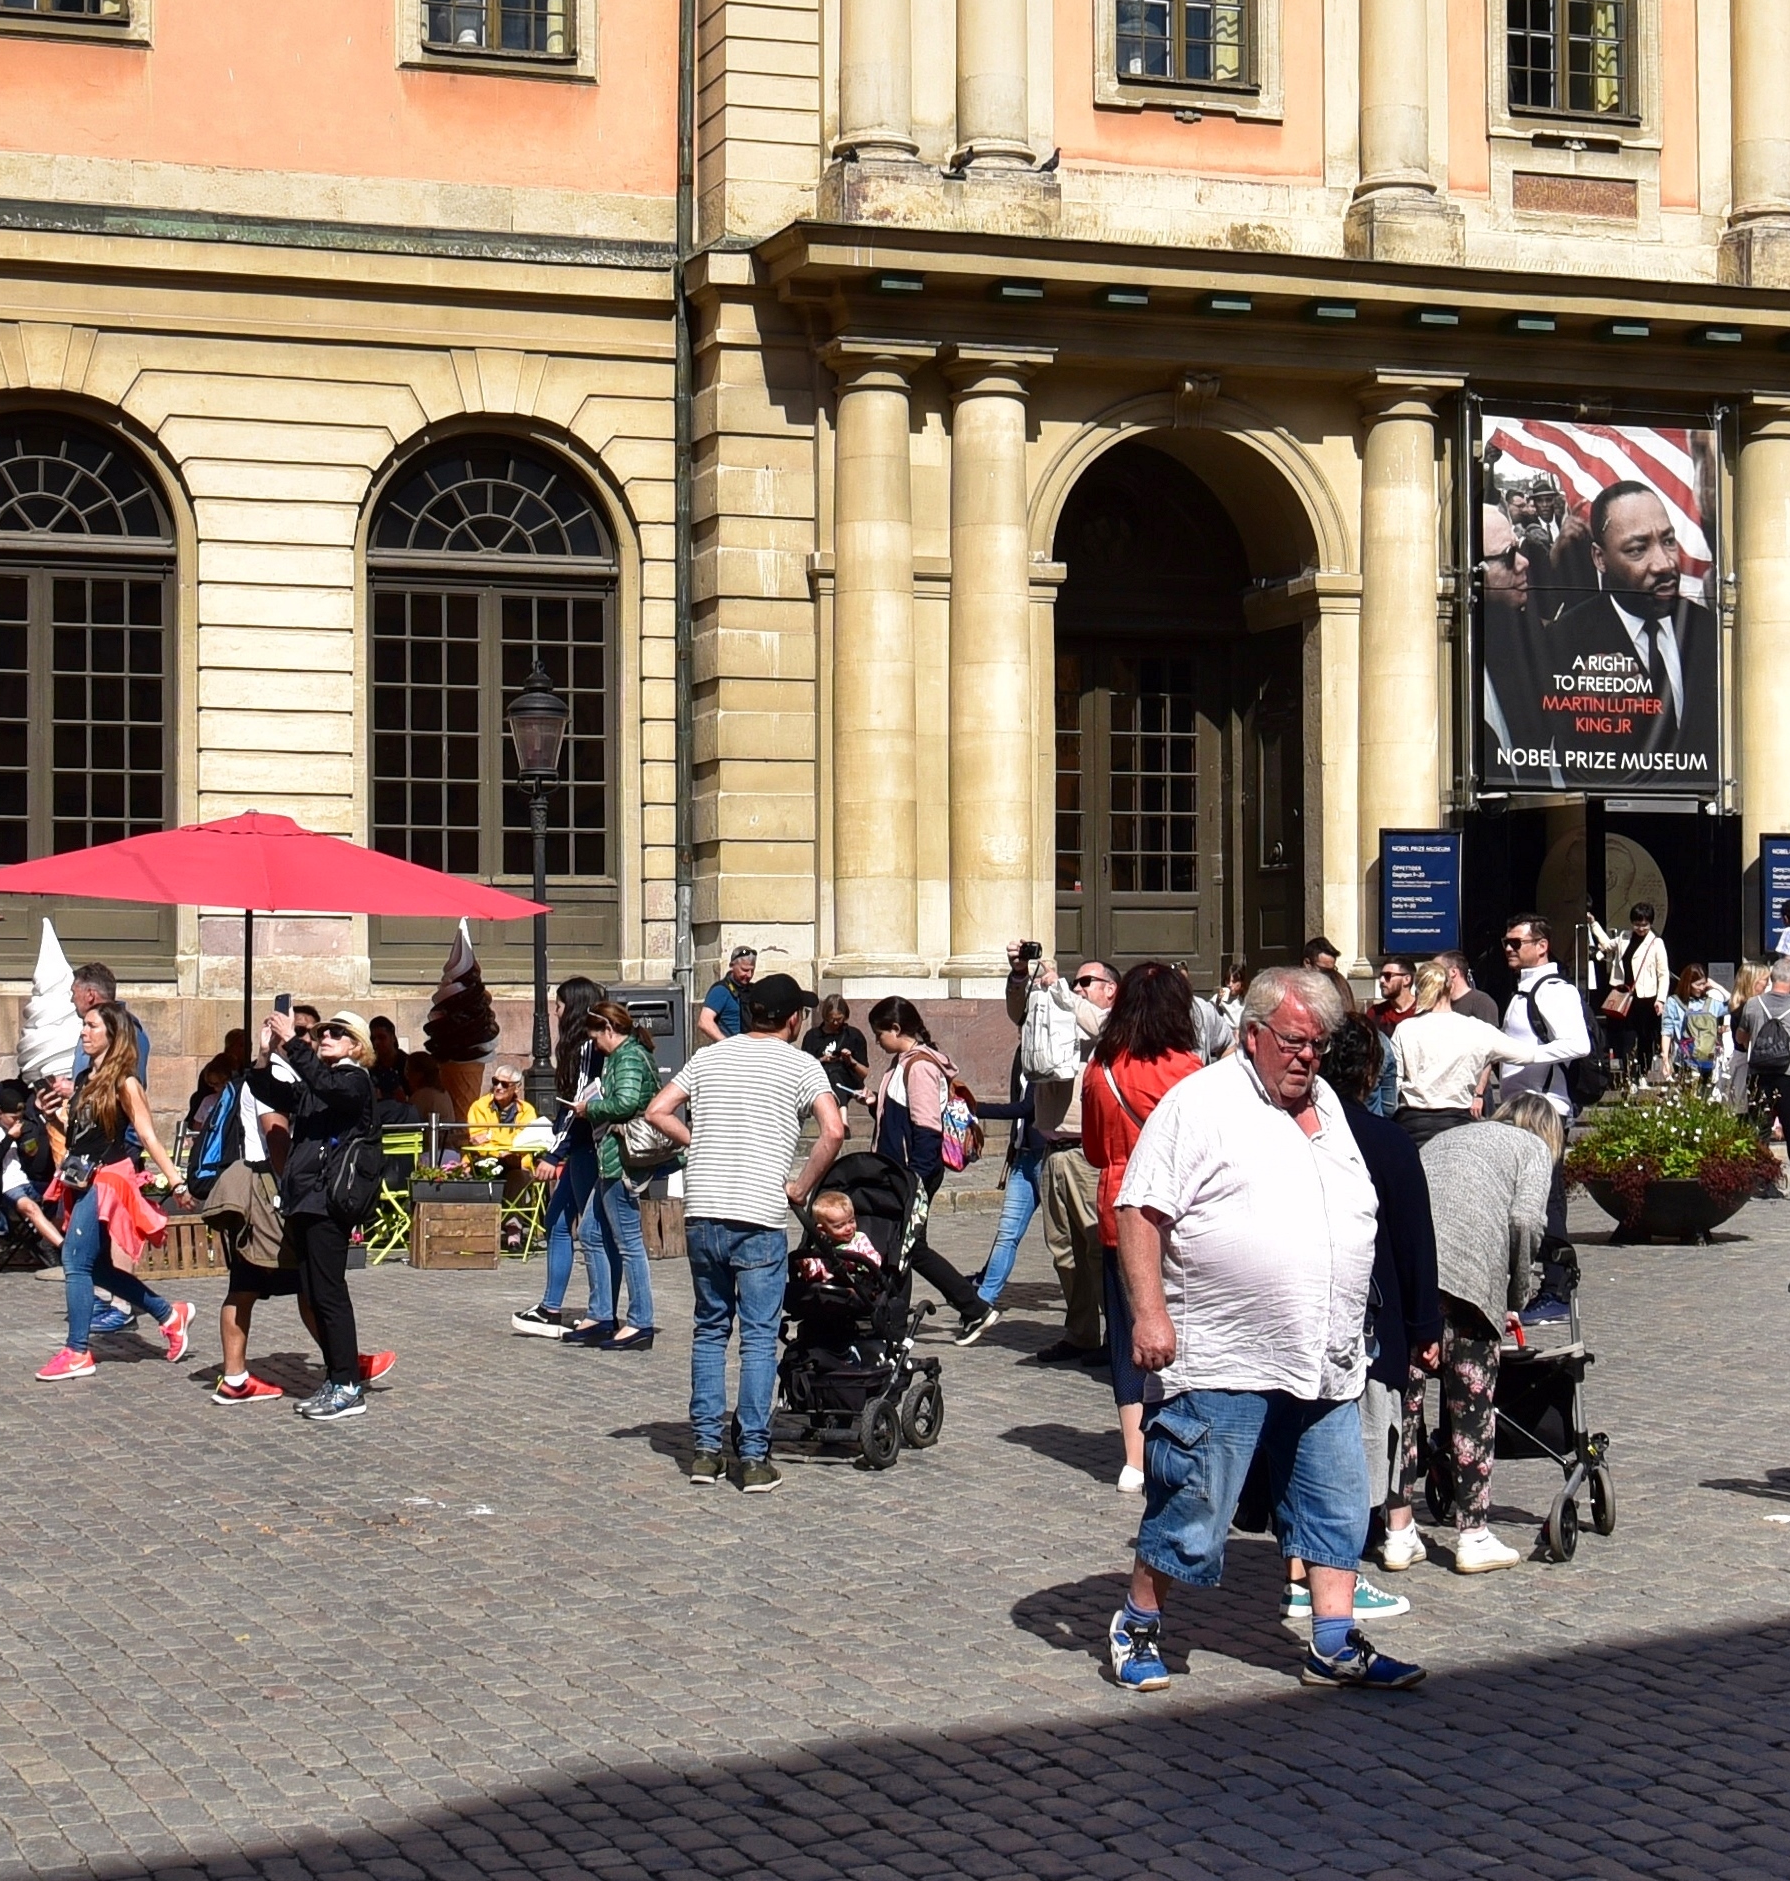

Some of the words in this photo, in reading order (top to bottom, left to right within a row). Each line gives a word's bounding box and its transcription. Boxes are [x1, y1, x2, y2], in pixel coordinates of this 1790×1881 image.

[1572, 655, 1585, 670] A
[1588, 655, 1634, 672] RIGHT
[1553, 674, 1575, 691] TO
[1578, 676, 1653, 693] FREEDOM
[1542, 695, 1604, 713] MARTIN
[1608, 697, 1664, 715] LUTHER
[1575, 717, 1612, 733] KING
[1614, 718, 1632, 734] JR
[1497, 747, 1562, 768] NOBEL
[1564, 750, 1616, 769] PRIZE
[1620, 752, 1708, 771] MUSEUM
